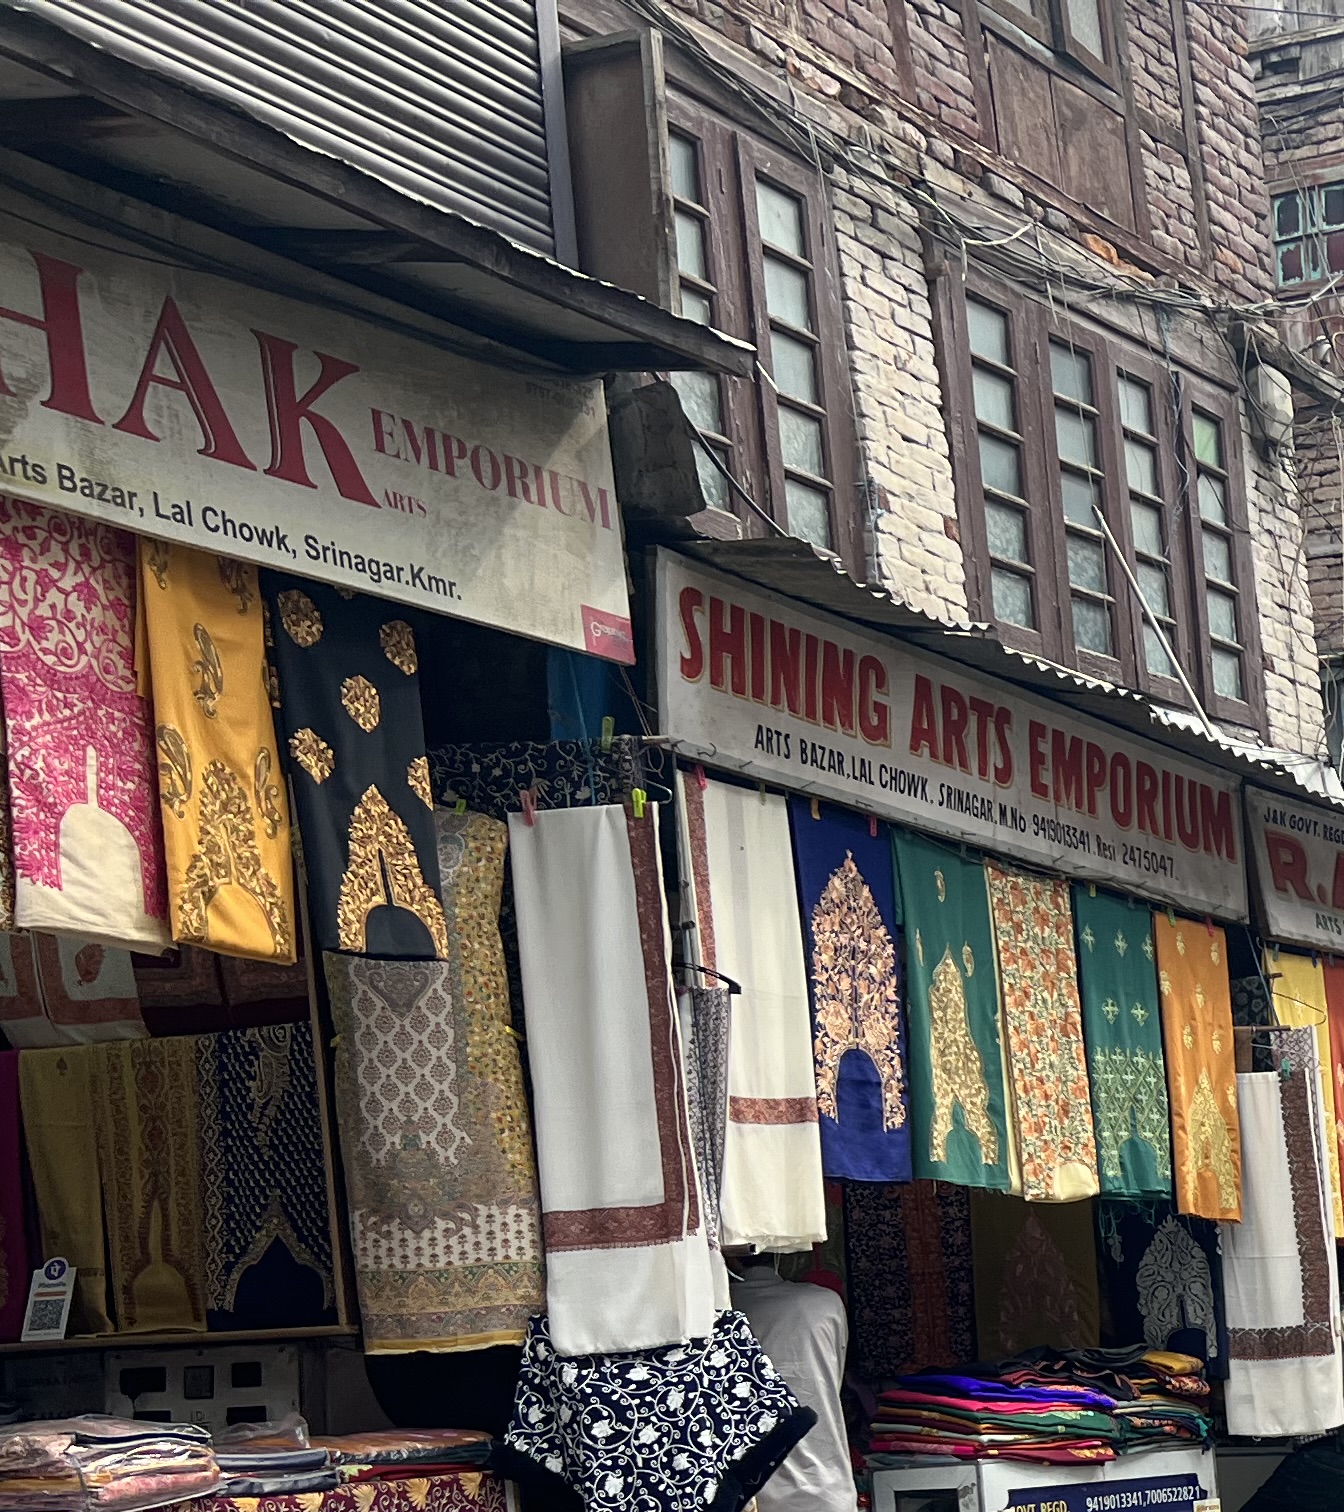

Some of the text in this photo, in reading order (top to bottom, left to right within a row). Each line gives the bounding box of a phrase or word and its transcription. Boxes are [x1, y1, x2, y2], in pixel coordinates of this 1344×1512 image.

[369, 406, 613, 532] EMPORIUM
[57, 463, 145, 518] Bazar,
[153, 491, 194, 527] Lal
[201, 505, 297, 559] Chowk,
[383, 488, 428, 519] ARTS
[678, 585, 1239, 864] SHINING ARTS EMPORIUM
[754, 723, 791, 760] ARTS
[1264, 806, 1287, 828] J&K
[1315, 912, 1342, 936] ARTS
